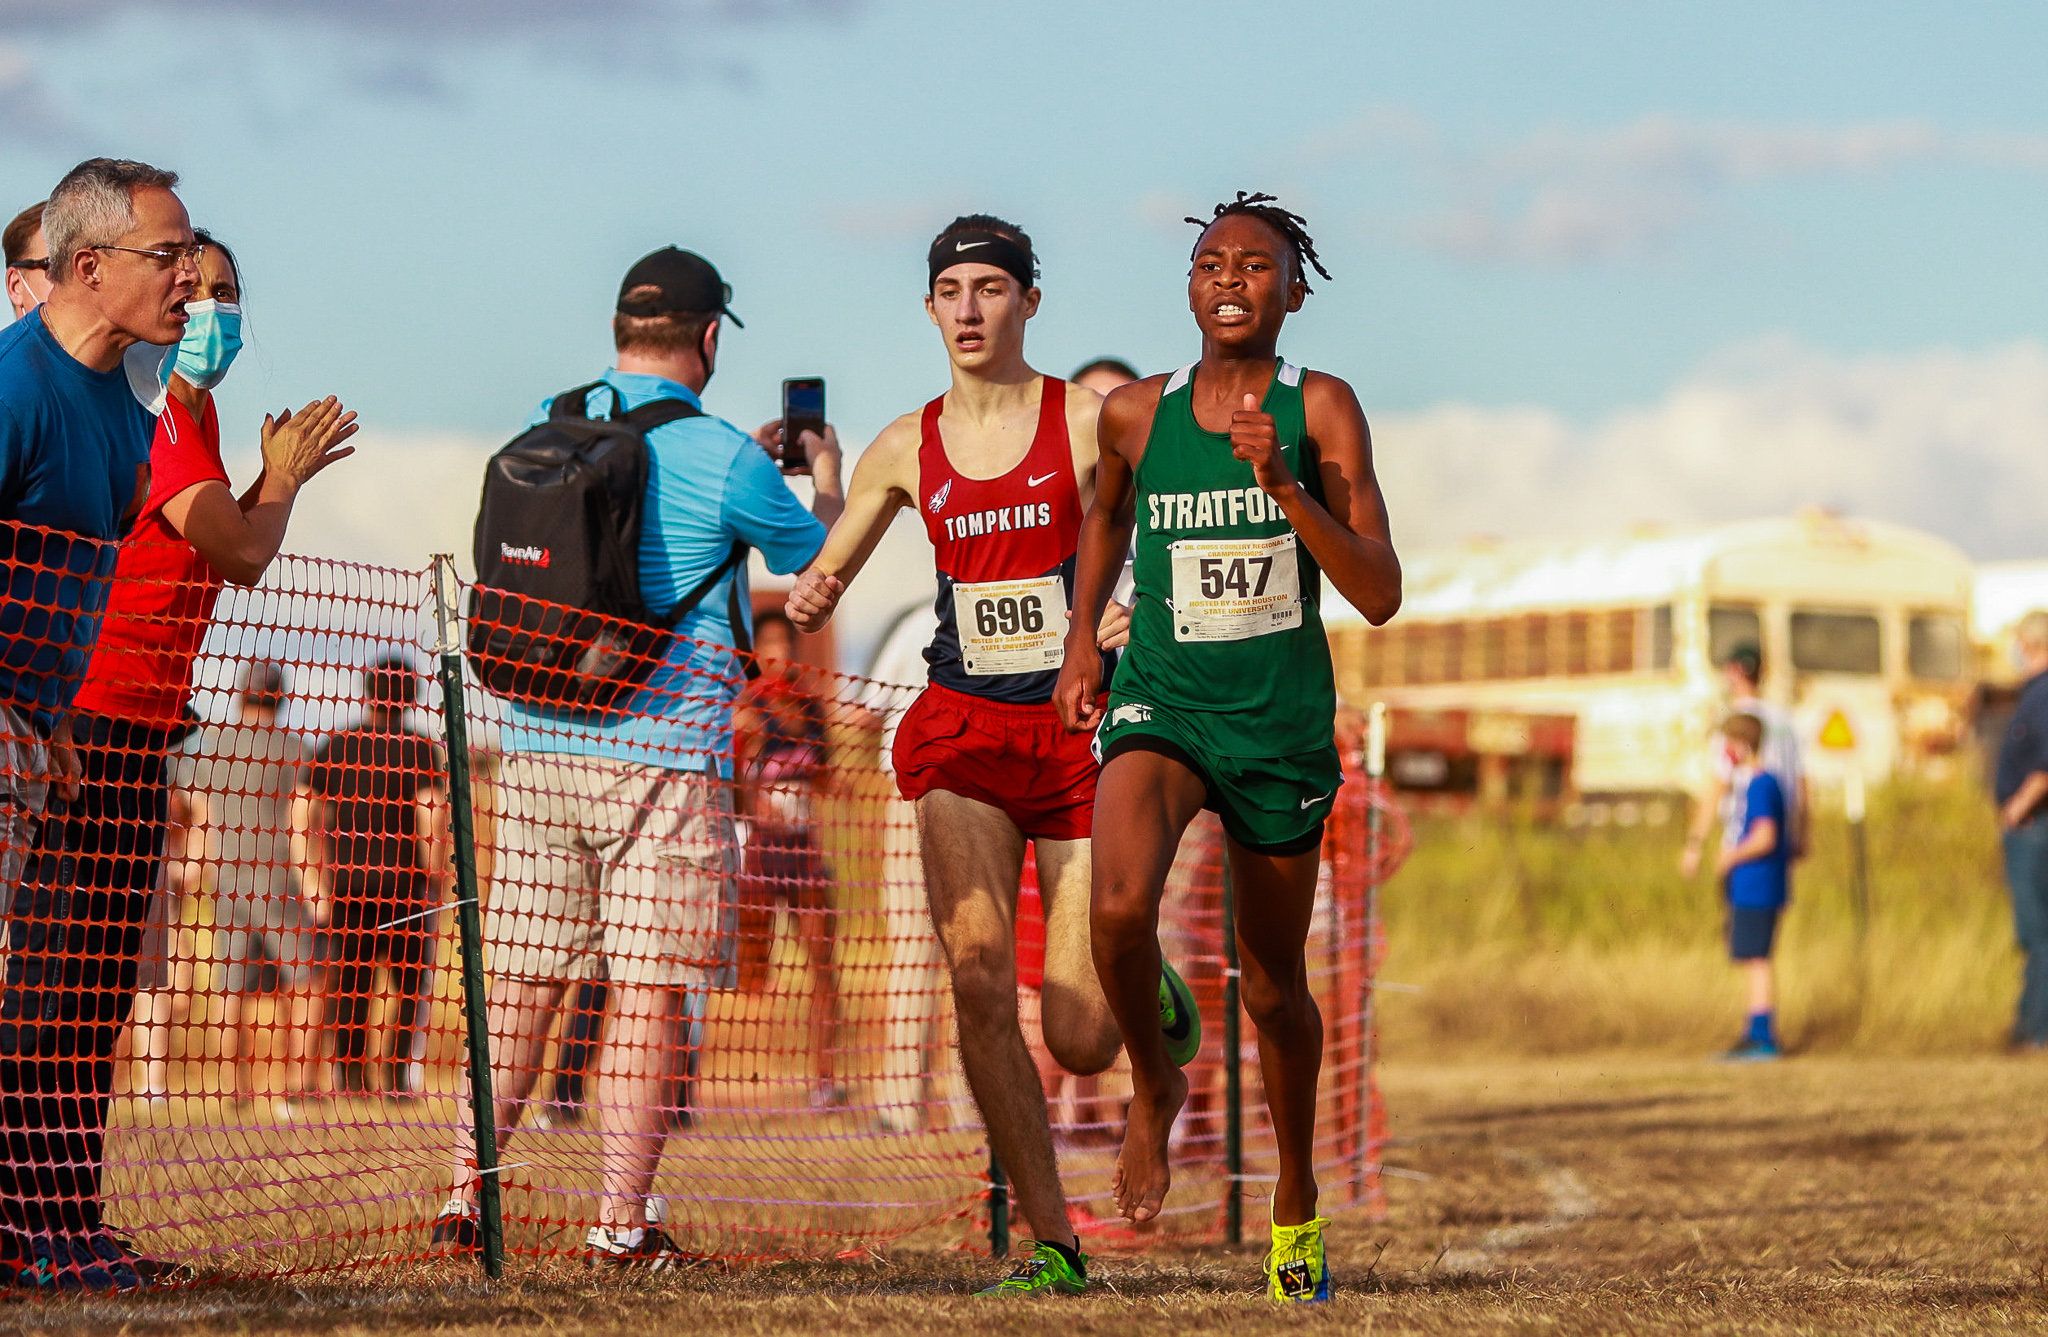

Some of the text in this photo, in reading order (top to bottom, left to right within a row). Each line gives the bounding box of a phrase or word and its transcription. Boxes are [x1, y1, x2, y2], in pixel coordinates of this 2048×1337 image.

[944, 502, 1051, 541] TOMPKINS
[1252, 540, 1285, 549] REGIONAL
[1199, 556, 1273, 599] 547
[1252, 594, 1288, 605] HOUSTON
[1228, 604, 1274, 614] UNIVERSITY
[975, 595, 1044, 637] 696
[1023, 631, 1057, 640] HOUSTON
[1002, 641, 1045, 649] UNIVERSITY
